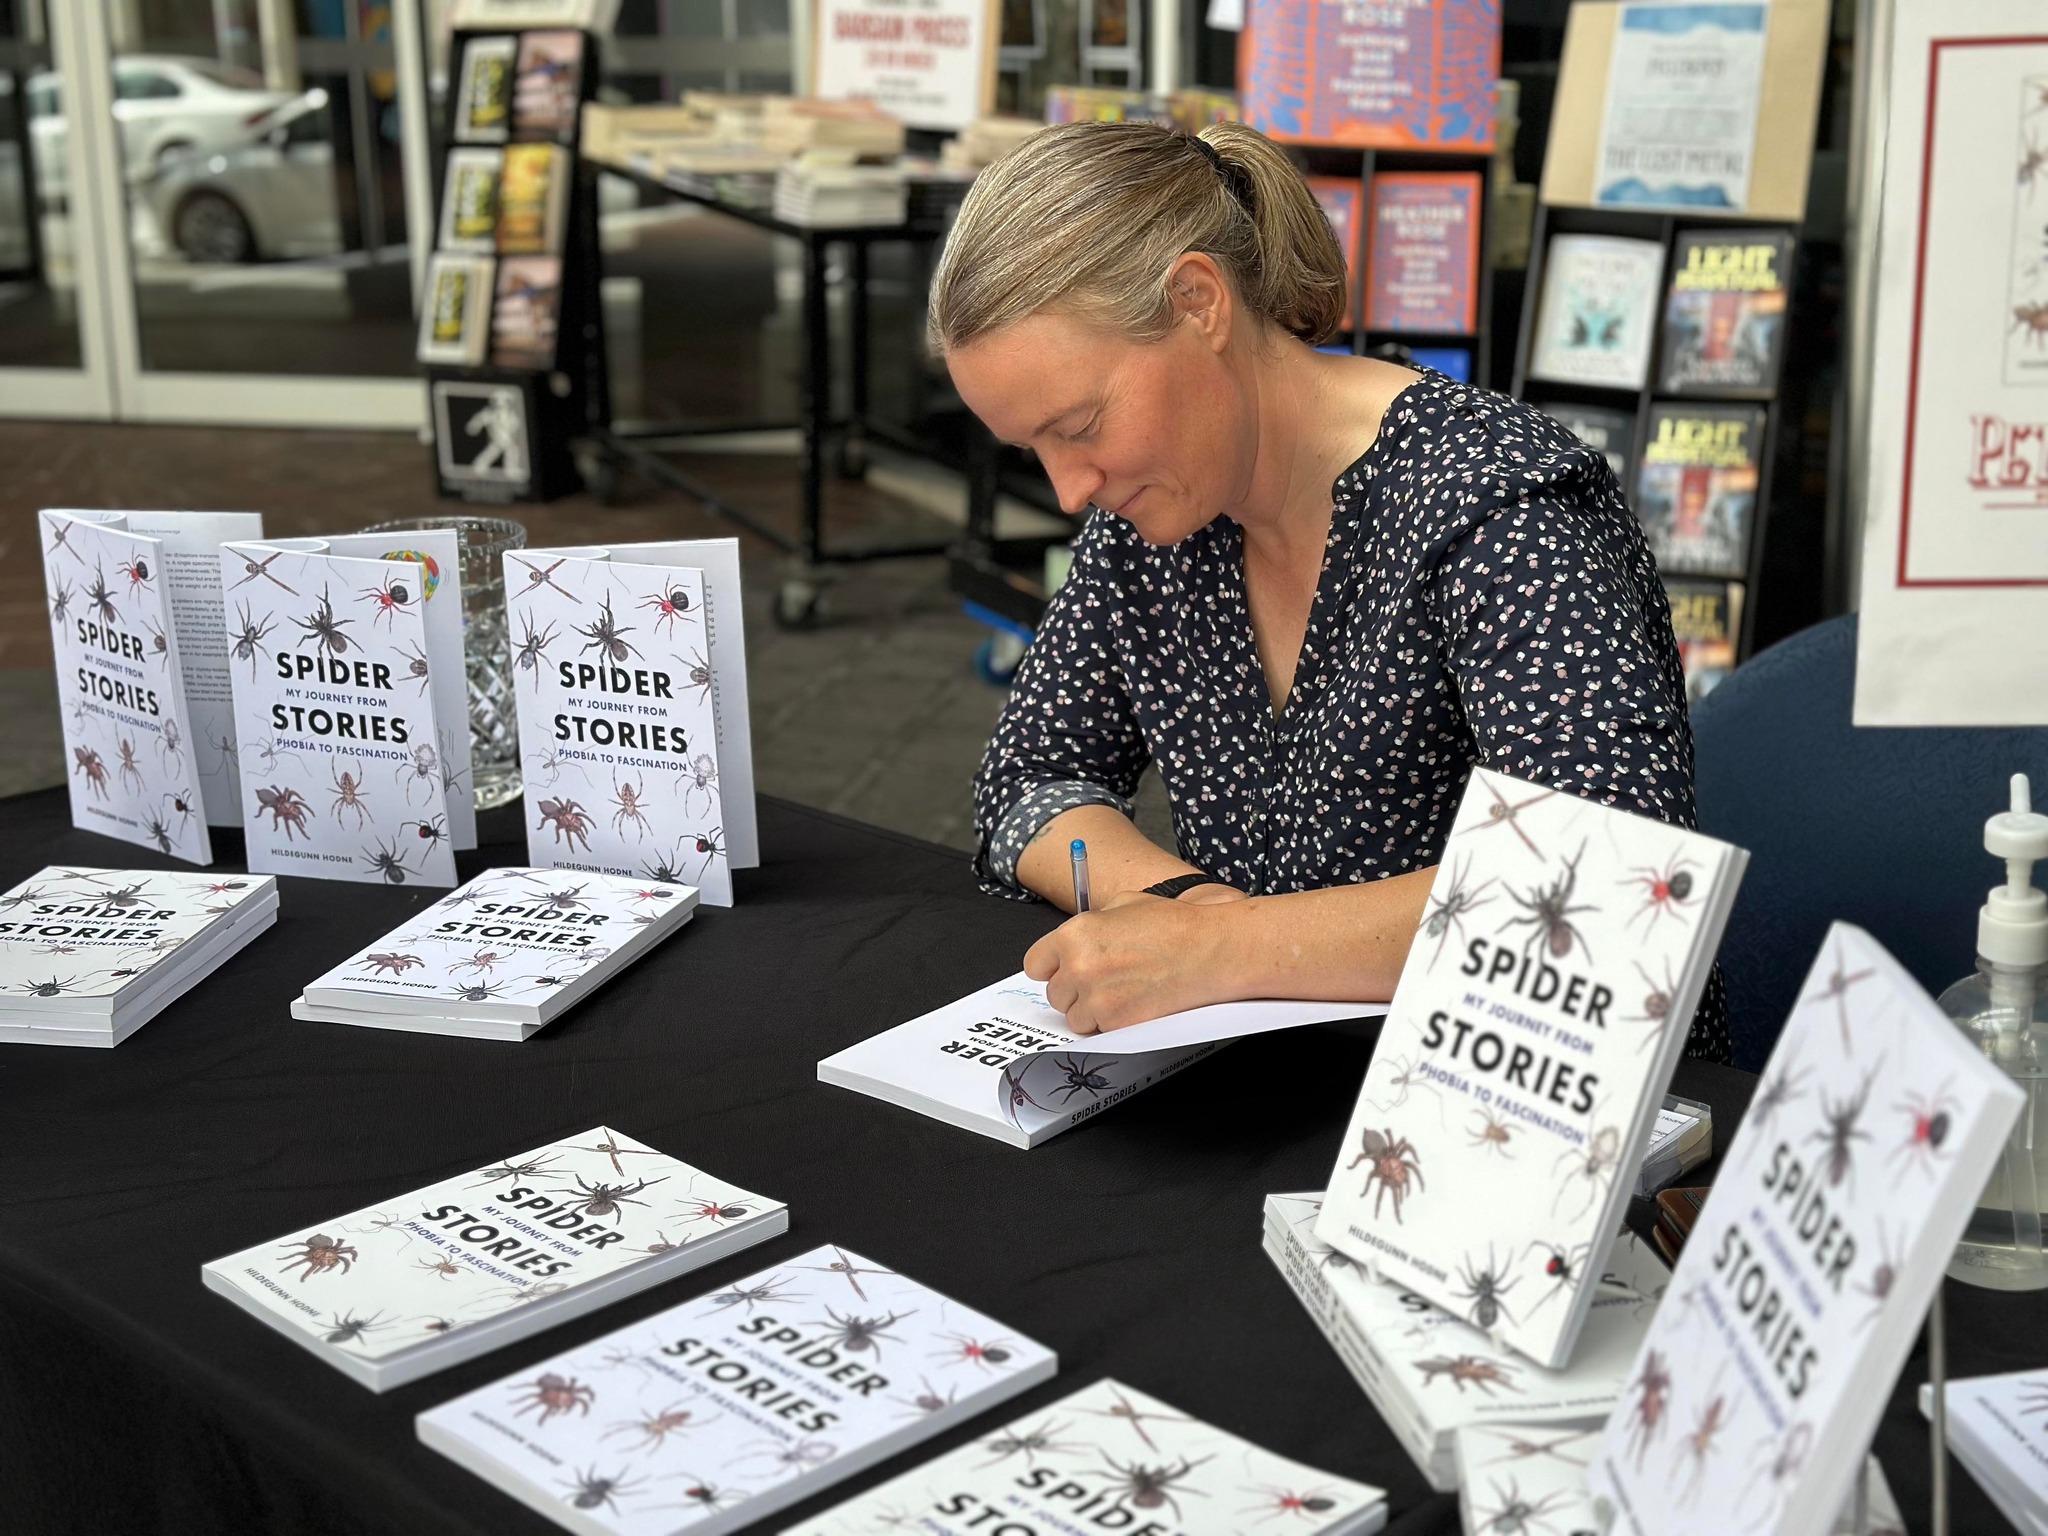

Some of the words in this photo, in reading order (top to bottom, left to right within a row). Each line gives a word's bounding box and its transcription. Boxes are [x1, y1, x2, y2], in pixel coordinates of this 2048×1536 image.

[1686, 245, 1777, 272] LIGHT
[1658, 418, 1747, 444] LIGHT
[78, 618, 146, 663] SPIDER
[84, 653, 94, 663] MY
[95, 657, 123, 673] JOURNEY
[125, 667, 144, 680] FROM
[277, 652, 394, 690] SPIDER
[559, 661, 674, 699] SPIDER
[78, 667, 159, 716] STORIES
[286, 688, 301, 698] MY
[305, 691, 353, 704] JOURNEY
[357, 696, 388, 708] FROM
[82, 701, 105, 716] PHOBIA
[107, 709, 116, 719] TO
[117, 712, 161, 733] FASCINATION
[568, 697, 583, 707] MY
[587, 700, 634, 713] JOURNEY
[638, 705, 668, 717] FROM
[272, 704, 408, 744] STORIES
[554, 713, 688, 754] STORIES
[277, 738, 316, 751] PHOBIA
[319, 743, 333, 753] TO
[336, 746, 408, 761] FASCINATION
[559, 749, 598, 762] PHOBIA
[600, 754, 614, 763] TO
[617, 756, 687, 772] FASCINATION
[271, 849, 320, 860] HILDEGUNN
[322, 854, 353, 864] HODNE
[554, 861, 600, 873] HILDEGUNN
[603, 867, 633, 877] HODNE
[31, 904, 178, 921] SPIDER
[57, 918, 119, 926] JOURNEY
[474, 903, 610, 926] SPIDER
[495, 918, 551, 929] JOURNEY
[552, 924, 587, 932] FROM
[61, 939, 149, 947] FASCINATION
[427, 934, 473, 943] PHOBIA
[496, 941, 578, 953] FASCINATION
[434, 921, 598, 946] STORIES
[341, 976, 400, 986] HILDEGUNN
[402, 982, 438, 990] HODNE
[1460, 937, 1614, 1029] SPIDER
[967, 1022, 1059, 1051] RIES
[992, 1017, 1059, 1039] FASCINATION
[1463, 992, 1486, 1010] MY
[1488, 1003, 1552, 1037] JOURNEY
[1555, 1028, 1594, 1055] FROM
[940, 1040, 1011, 1070] IDER
[969, 1036, 999, 1049] FROM
[999, 1046, 1028, 1057] RNEY
[1421, 1010, 1599, 1115] STORIES
[1071, 1102, 1101, 1124] SPIDER
[1103, 1083, 1137, 1107] STORIES
[1419, 1062, 1470, 1094] PHOBIA
[1474, 1085, 1493, 1103] TO
[1494, 1095, 1585, 1145] FASCINATION
[482, 1205, 503, 1218] MY
[500, 1216, 551, 1242] JOURNEY
[549, 1240, 583, 1257] FROM
[495, 1187, 625, 1250] SPIDER
[1762, 1141, 1857, 1294] SPIDER
[403, 1221, 446, 1246] PHOBIA
[444, 1244, 462, 1255] TO
[460, 1252, 533, 1288] FASCINATION
[421, 1205, 573, 1277] STORIES
[1285, 1229, 1306, 1259] SPIDER
[1284, 1245, 1305, 1276] SPIDER
[243, 1267, 293, 1300] HILDEGUNN
[288, 1298, 322, 1317] HODNE
[1713, 1223, 1818, 1399] STORIES
[737, 1316, 890, 1398] SPIDER
[660, 1337, 840, 1433] STORIES
[1014, 1467, 1187, 1536] SPIDE
